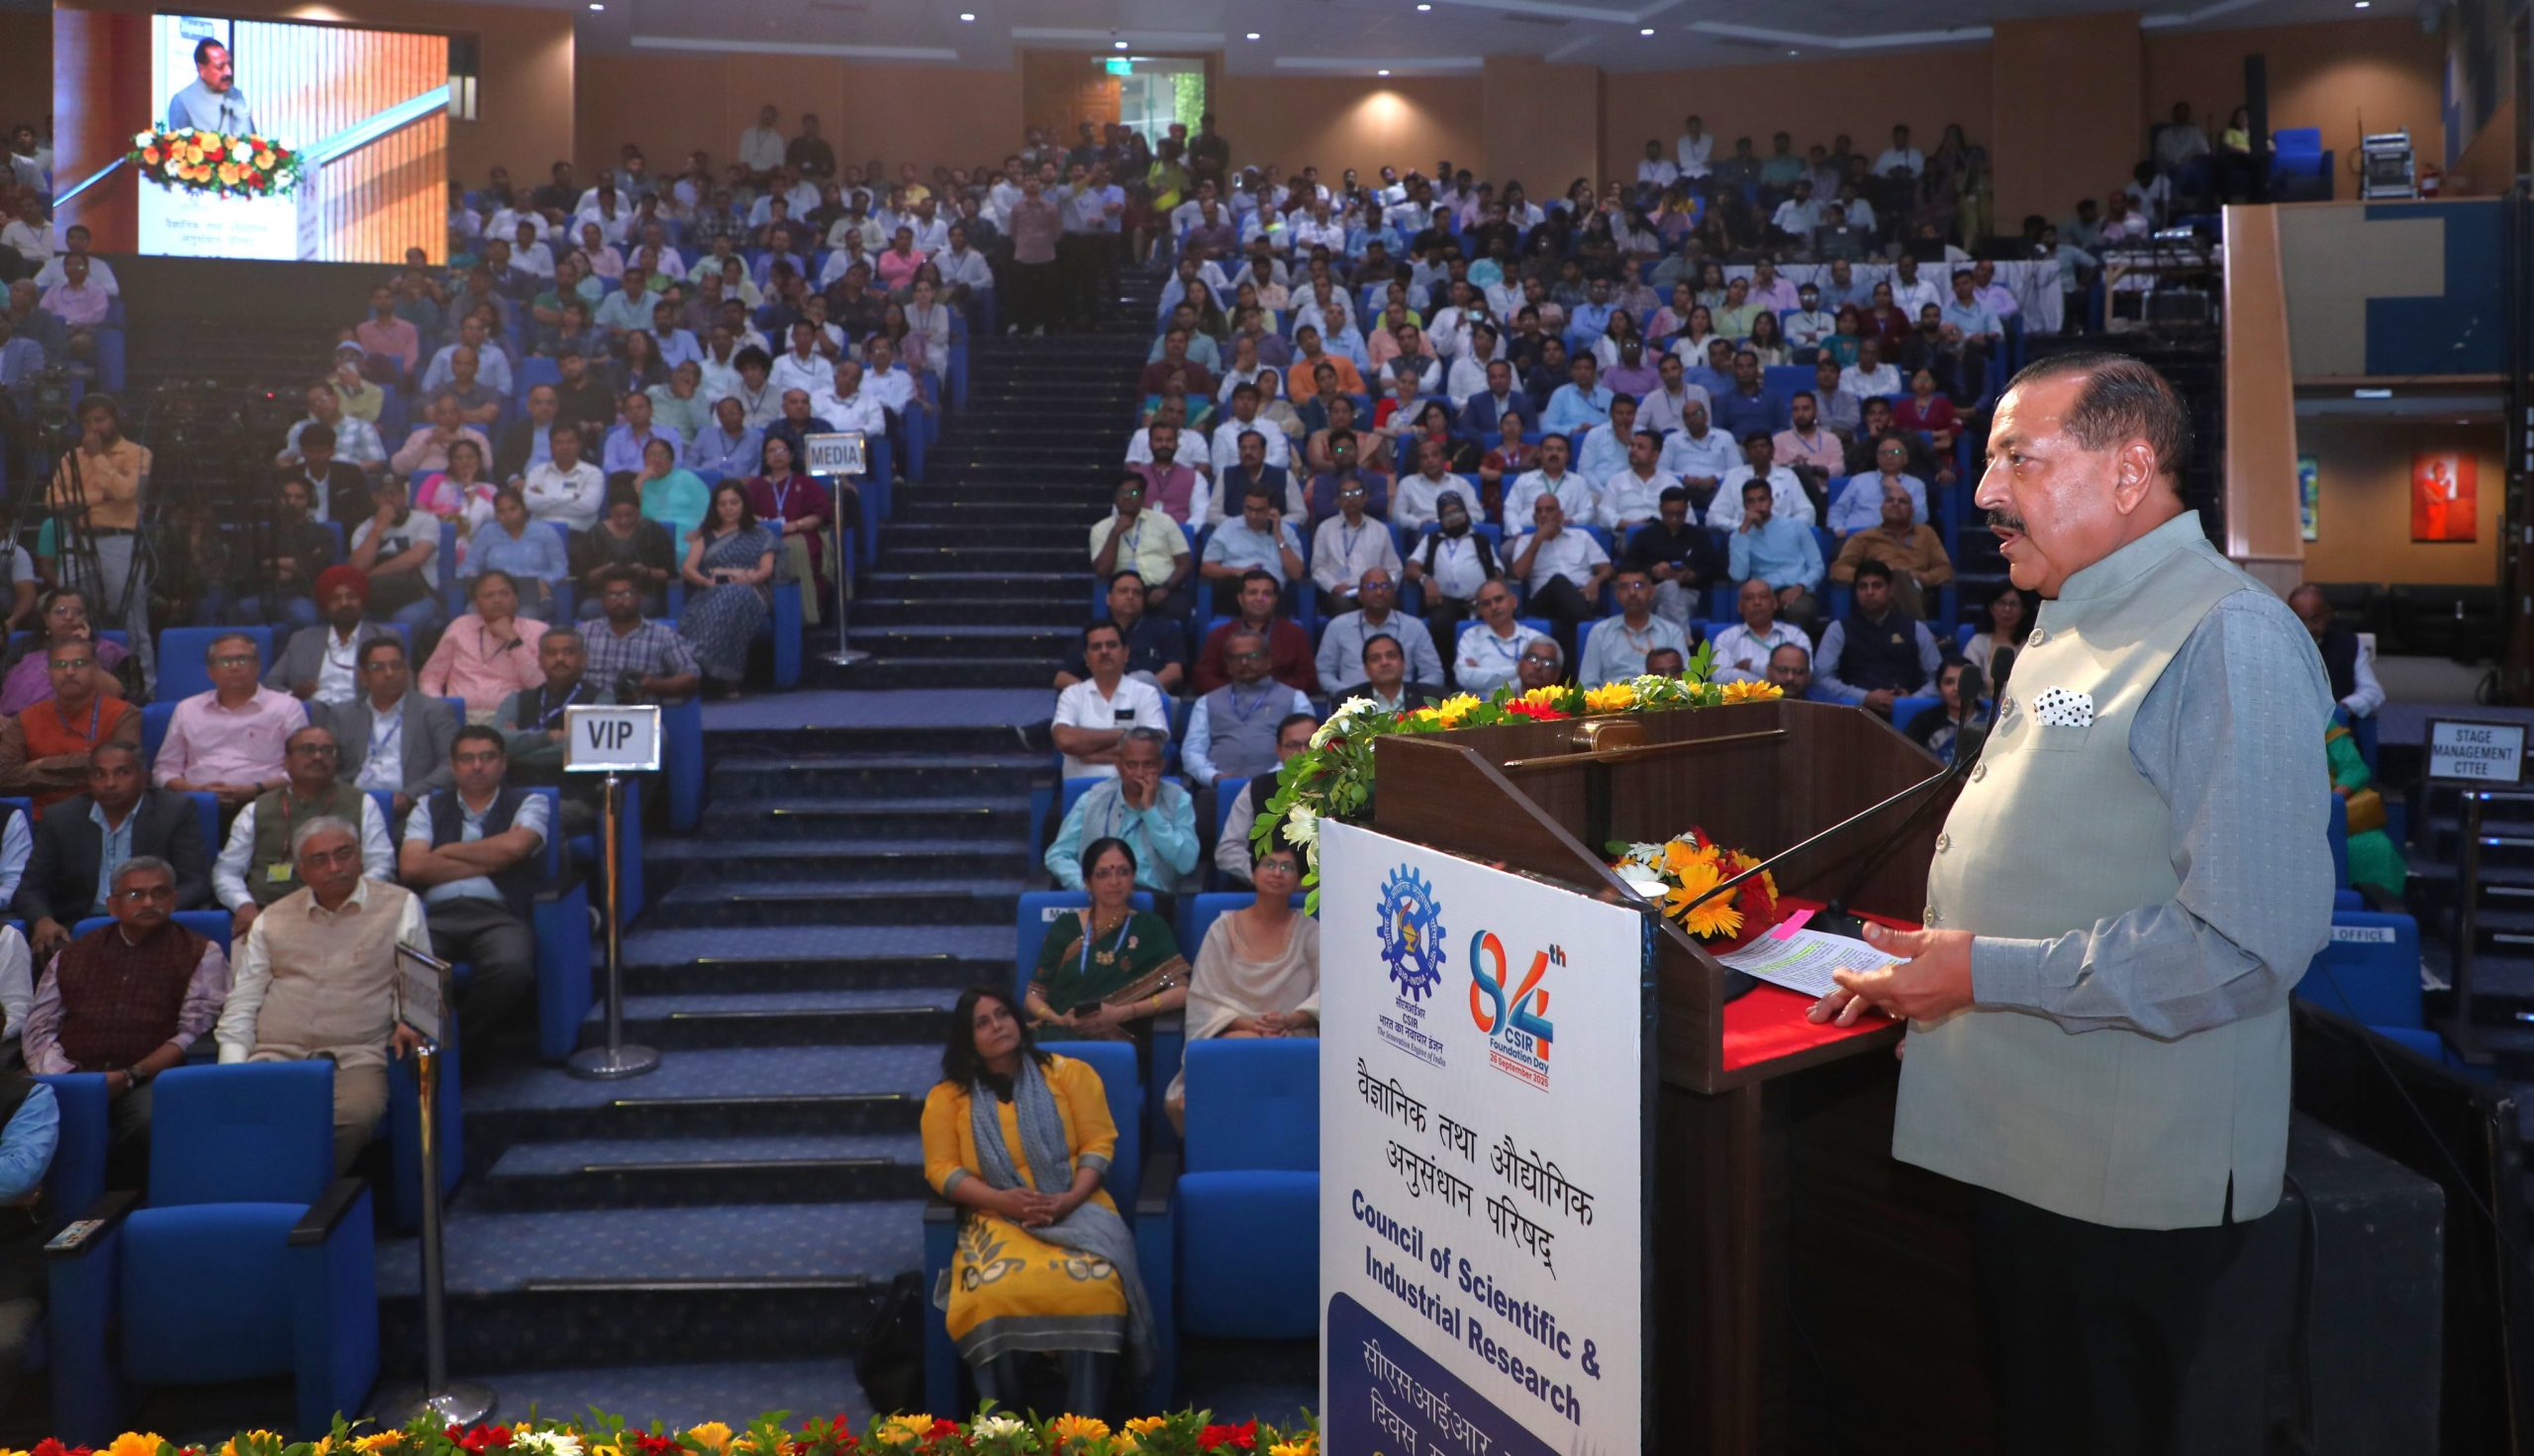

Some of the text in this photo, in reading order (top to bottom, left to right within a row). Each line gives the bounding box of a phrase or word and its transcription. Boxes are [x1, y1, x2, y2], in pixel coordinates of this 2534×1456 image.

[811, 445, 858, 465] MEDIA
[587, 721, 633, 749] VIP
[2433, 744, 2513, 760] MANAGEMENT
[2456, 729, 2492, 743] STAGE
[2455, 761, 2488, 775] CTTEE
[2339, 928, 2385, 940] OFFICE
[1396, 996, 1425, 1019] सीएसआईआर
[1403, 1014, 1417, 1029] CSIR
[1379, 1015, 1443, 1053] भारत का नवाचार इंजन
[1386, 1031, 1410, 1049] Innovation
[1411, 1043, 1426, 1057] Engine
[1427, 1052, 1433, 1062] of
[1433, 1054, 1445, 1067] India
[1505, 1027, 1533, 1053] CSIR
[1490, 1038, 1549, 1075] Foundation Day
[1490, 1053, 1549, 1088] 26 September 2025
[1357, 1057, 1594, 1226] वैज्ञानिक तथा औद्योगिक
[1387, 1139, 1556, 1281] अनुसंधान परिषद्
[1352, 1188, 1602, 1381] Council of Scientific &
[1366, 1245, 1581, 1426] Industrial Research
[1363, 1338, 1493, 1456] सीएसआईआर
[1370, 1387, 1417, 1456] दिवस
